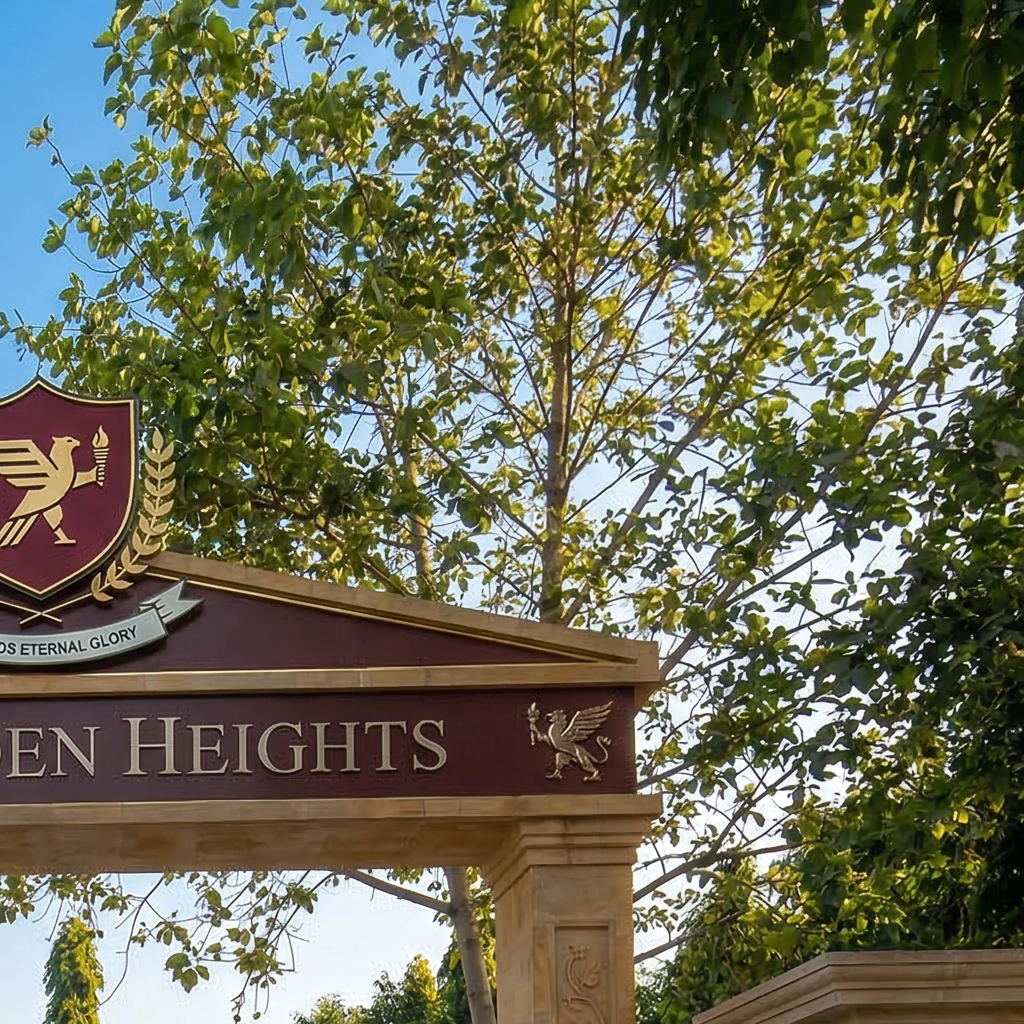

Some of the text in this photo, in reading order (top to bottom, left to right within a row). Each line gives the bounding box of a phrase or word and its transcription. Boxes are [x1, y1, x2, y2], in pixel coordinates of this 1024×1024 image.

[19, 640, 87, 656] ETERNAL
[89, 625, 138, 650] GLORY
[122, 716, 448, 776] HEIGHTS
